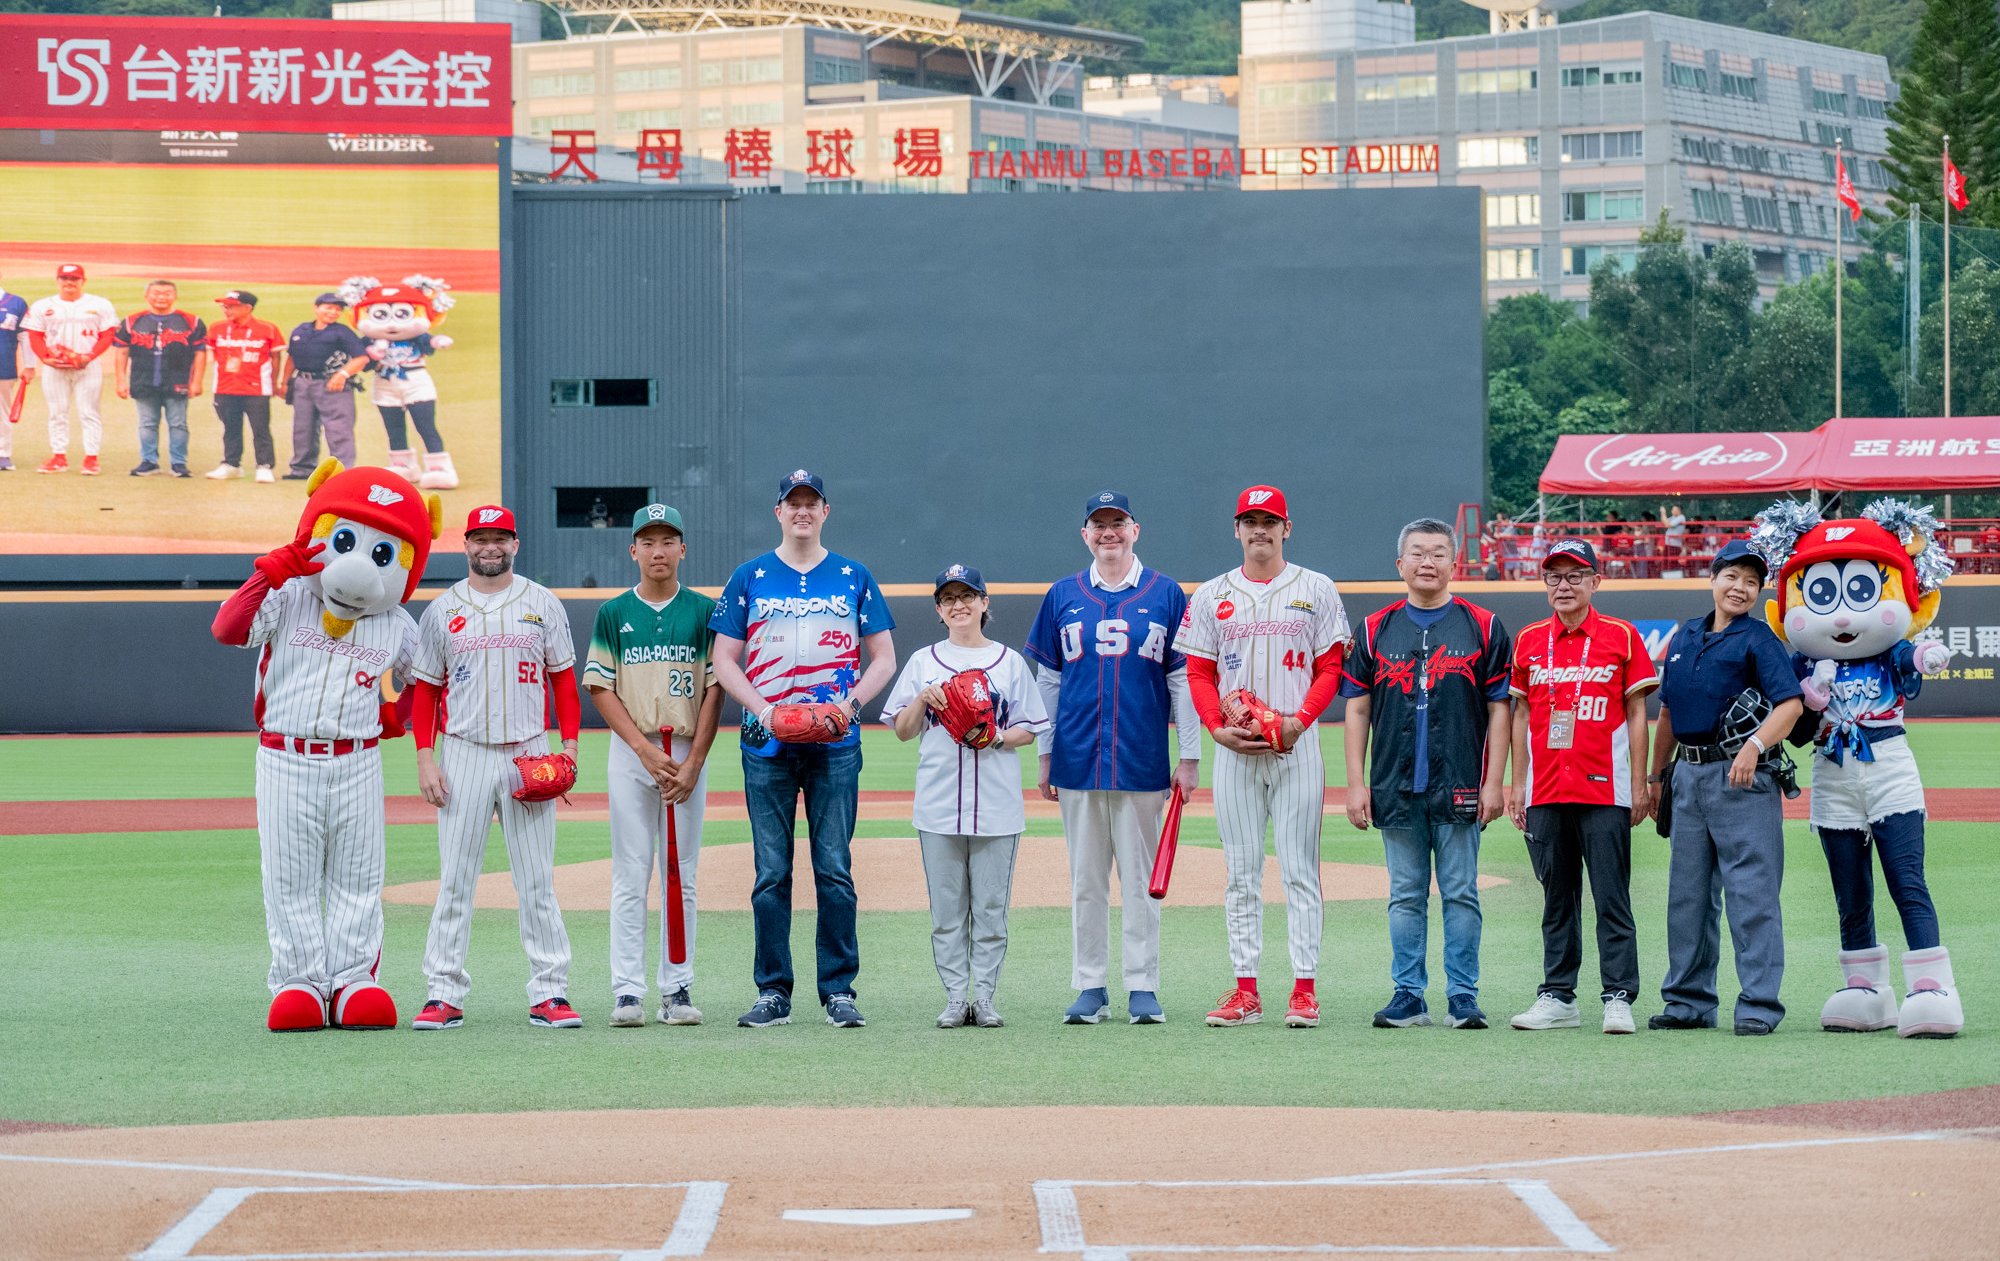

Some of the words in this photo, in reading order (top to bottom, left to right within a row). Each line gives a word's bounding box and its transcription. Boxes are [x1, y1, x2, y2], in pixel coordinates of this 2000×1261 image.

[122, 44, 492, 108] 台新新光金控
[548, 128, 943, 180] 天母棒球場
[969, 149, 1087, 178] TIANMU
[1105, 146, 1278, 178] BASEBALL
[1301, 144, 1439, 176] STADIUM
[1602, 443, 1772, 473] AirAsia
[755, 594, 851, 620] DRAGONS
[817, 630, 852, 650] 250
[623, 645, 697, 665] ASIA-PACIFIC
[1283, 649, 1306, 672] 44
[518, 661, 538, 684] 52
[669, 669, 696, 699] 23
[1577, 695, 1608, 722] 80
